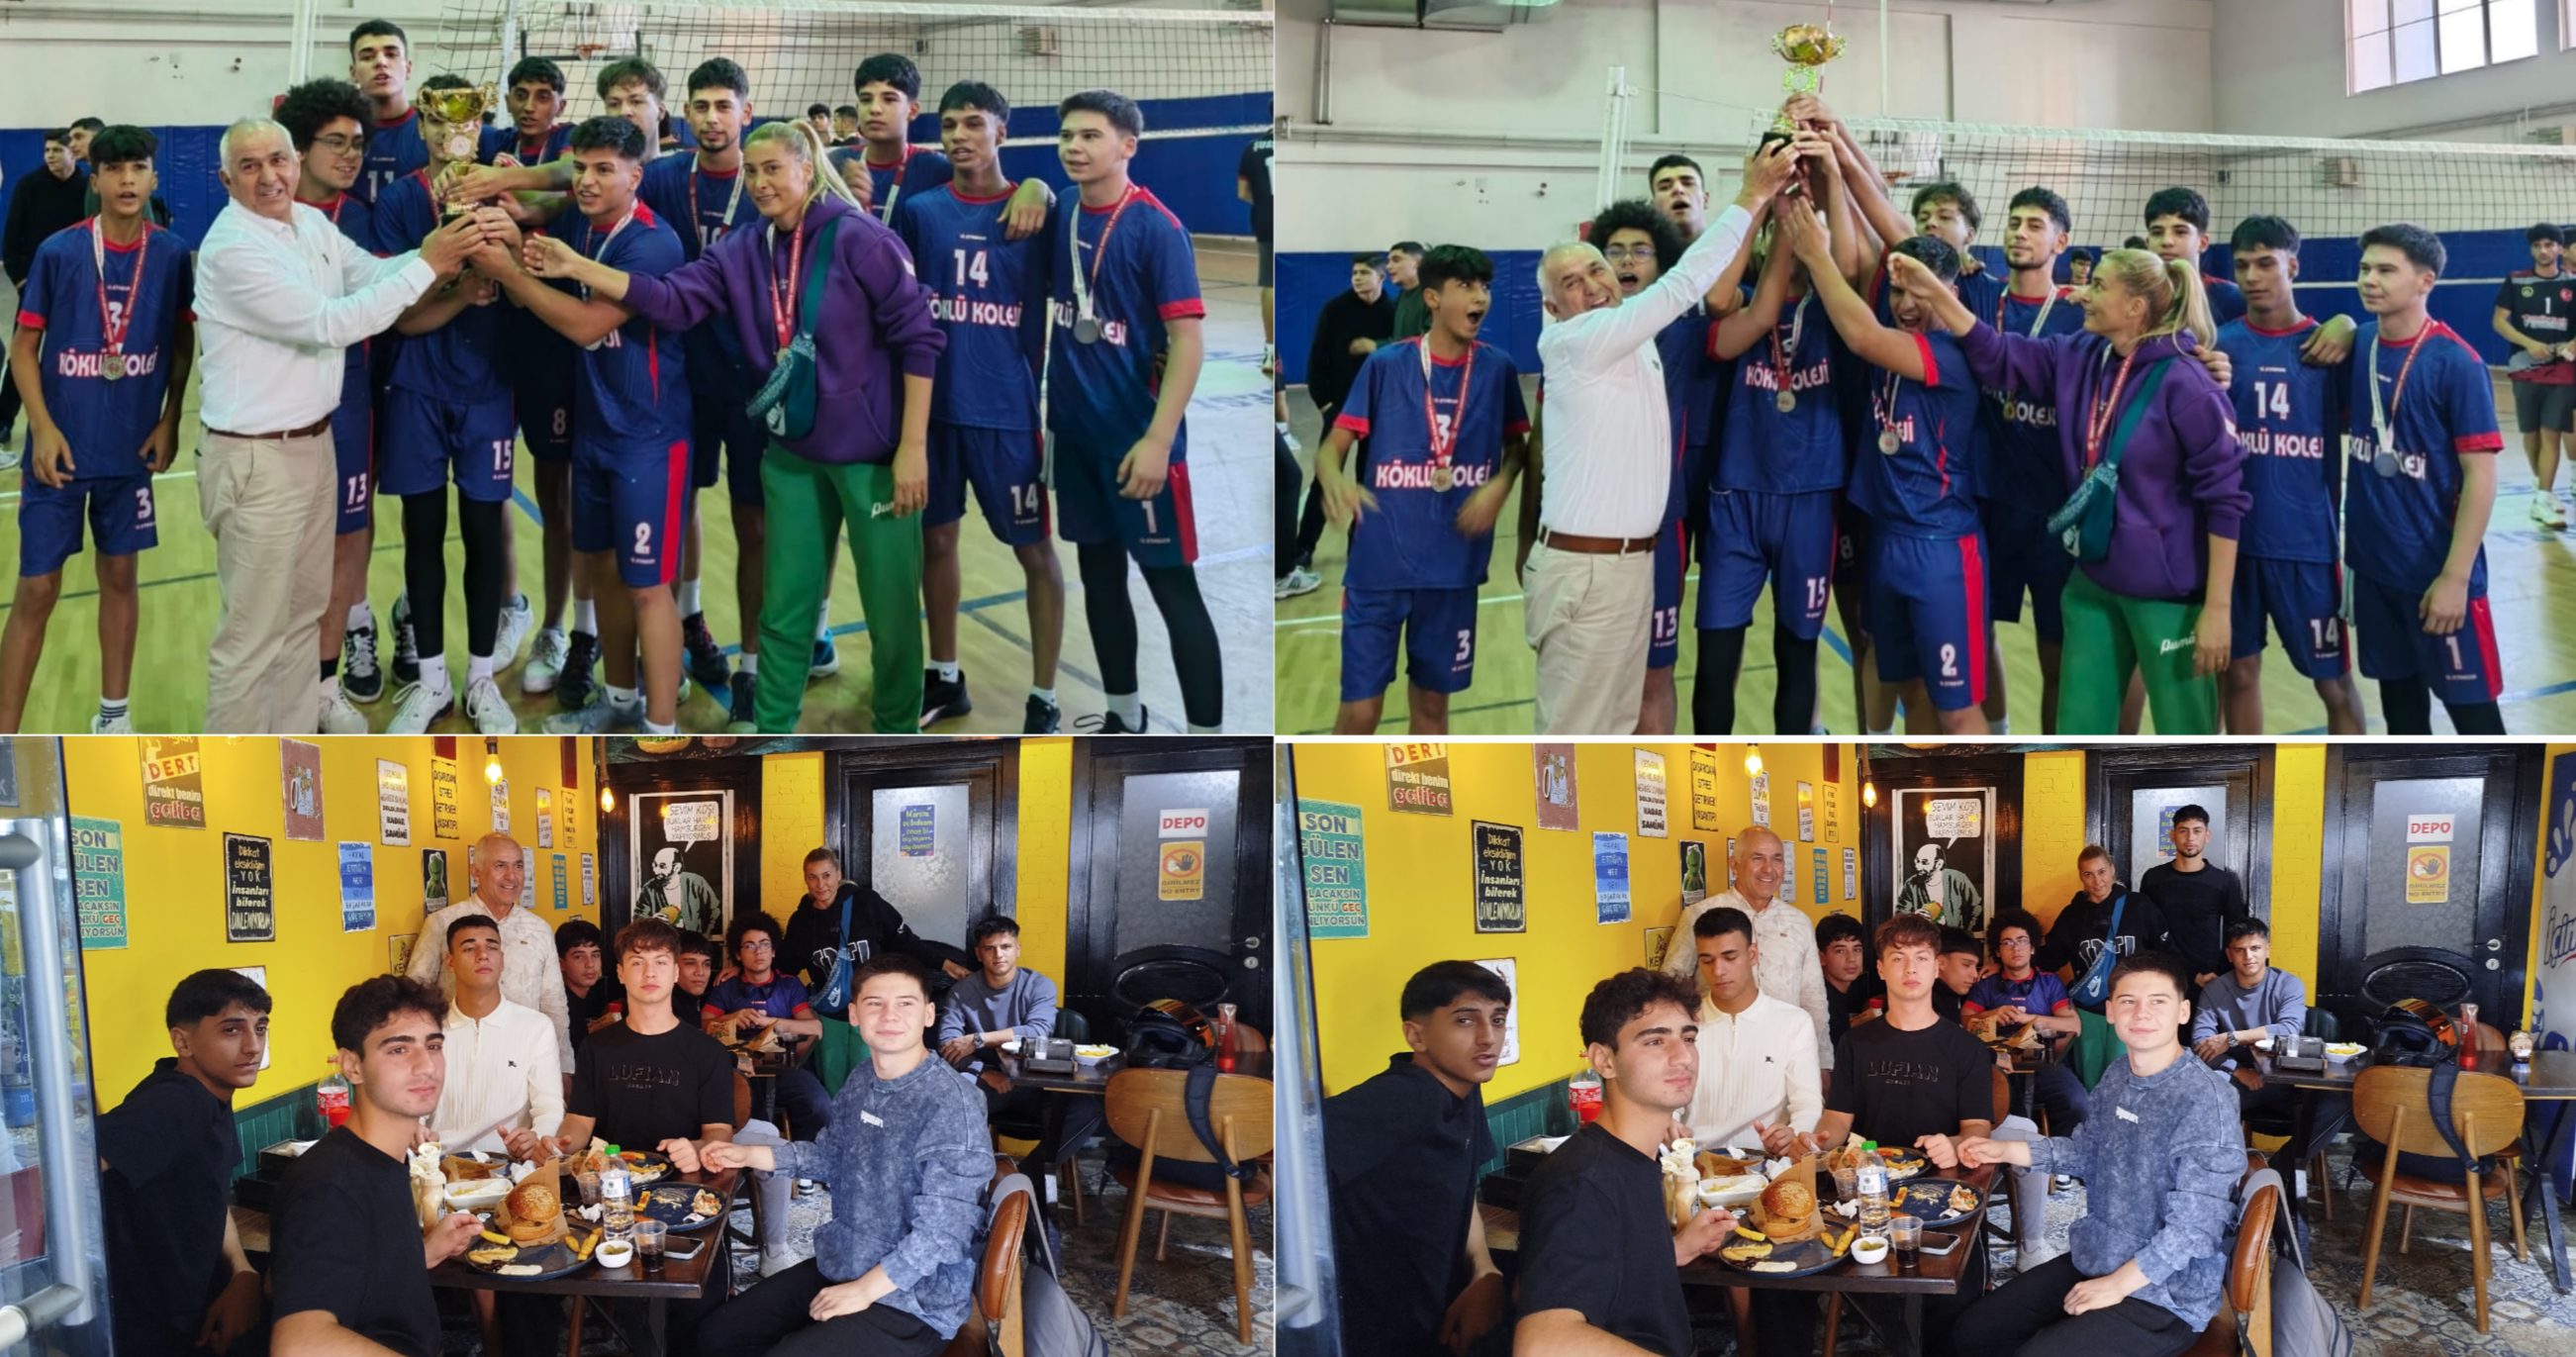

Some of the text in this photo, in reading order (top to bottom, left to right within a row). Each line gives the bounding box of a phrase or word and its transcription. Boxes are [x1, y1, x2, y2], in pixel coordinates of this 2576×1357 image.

[954, 248, 989, 288] 14
[928, 293, 966, 322] ÖKLÜ
[2544, 296, 2551, 315] 1
[104, 301, 123, 339] 3
[1791, 356, 1830, 391] OLEJİ
[2254, 381, 2290, 420] 14
[553, 408, 567, 436] 8
[493, 439, 512, 470] 15
[2275, 435, 2324, 459] KOLEJ
[347, 473, 367, 505] 13
[1010, 483, 1038, 516] 14
[136, 487, 151, 520] 3
[1141, 500, 1157, 533] 1
[634, 522, 651, 555] 2
[1806, 576, 1826, 610] 15
[1655, 607, 1677, 639] 13
[2310, 617, 2339, 649] 14
[1456, 630, 1471, 662] 3
[2445, 636, 2462, 671] 1
[1941, 643, 1957, 677] 2
[1391, 742, 1443, 764] DERT
[148, 755, 196, 780] DERT
[1391, 769, 1448, 789] direkt benim
[148, 785, 201, 803] direkt benim
[1394, 787, 1448, 808] galiba
[150, 802, 202, 822] galiba
[1644, 807, 1663, 817] KADAR
[1163, 817, 1205, 829] DEPO
[1305, 813, 1347, 833] SON
[2410, 822, 2451, 833] DEPO
[71, 829, 107, 848] SON
[1487, 833, 1510, 846] Dikkat
[73, 848, 119, 873] ÜLEN
[239, 845, 259, 857] Dikkat
[240, 870, 261, 882] YOK
[1310, 865, 1349, 884] SEN
[1489, 859, 1512, 873] YOK
[75, 879, 109, 897] SEN
[1480, 869, 1521, 886] İnsanları
[232, 881, 269, 896] İnsanları
[1306, 888, 1360, 900] LACAKSIN
[1484, 887, 1518, 898] bilerek
[78, 902, 119, 912] ACAKSIN
[237, 897, 266, 909] bilerek
[1307, 899, 1362, 916] ÜNKÜ GEÇ
[79, 911, 122, 927] NKÜ GEÇ
[1307, 916, 1365, 927] NLIYORSUN
[609, 1064, 680, 1087] LUFIAN
[1867, 1060, 1940, 1083] LUFIAN
